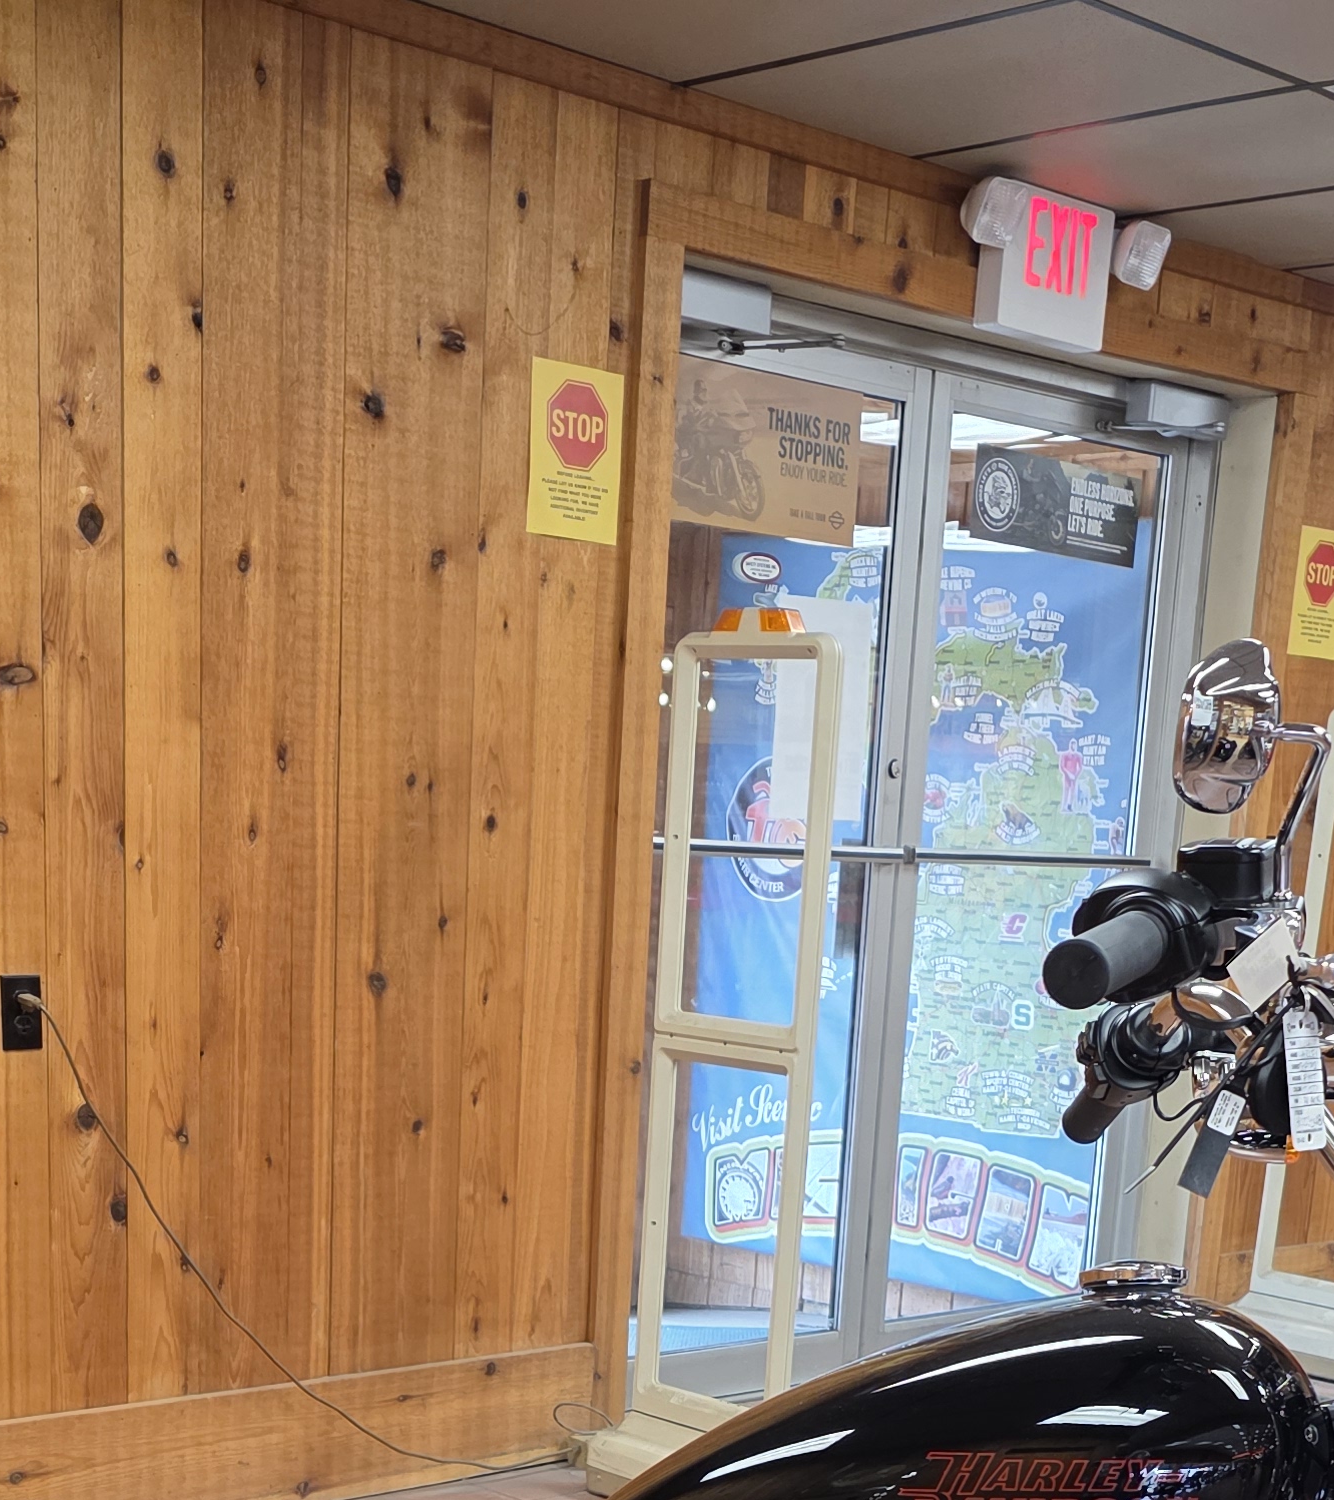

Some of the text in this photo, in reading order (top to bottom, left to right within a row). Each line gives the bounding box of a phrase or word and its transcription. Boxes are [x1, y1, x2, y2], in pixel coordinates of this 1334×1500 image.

[1025, 196, 1098, 299] EXIT
[551, 408, 604, 444] STOP
[768, 407, 851, 446] THANKS FOR
[778, 436, 849, 471] STOPPING.
[780, 461, 805, 482] ENJOY
[805, 466, 827, 485] YOUR
[1071, 477, 1101, 500] ENDLESS
[1069, 495, 1116, 522] ONE PURPOSE.
[1068, 514, 1104, 538] LET'S RIDE.
[749, 873, 784, 894] CENTER
[1013, 1003, 1031, 1026] S
[691, 1083, 823, 1152] Visit Scec
